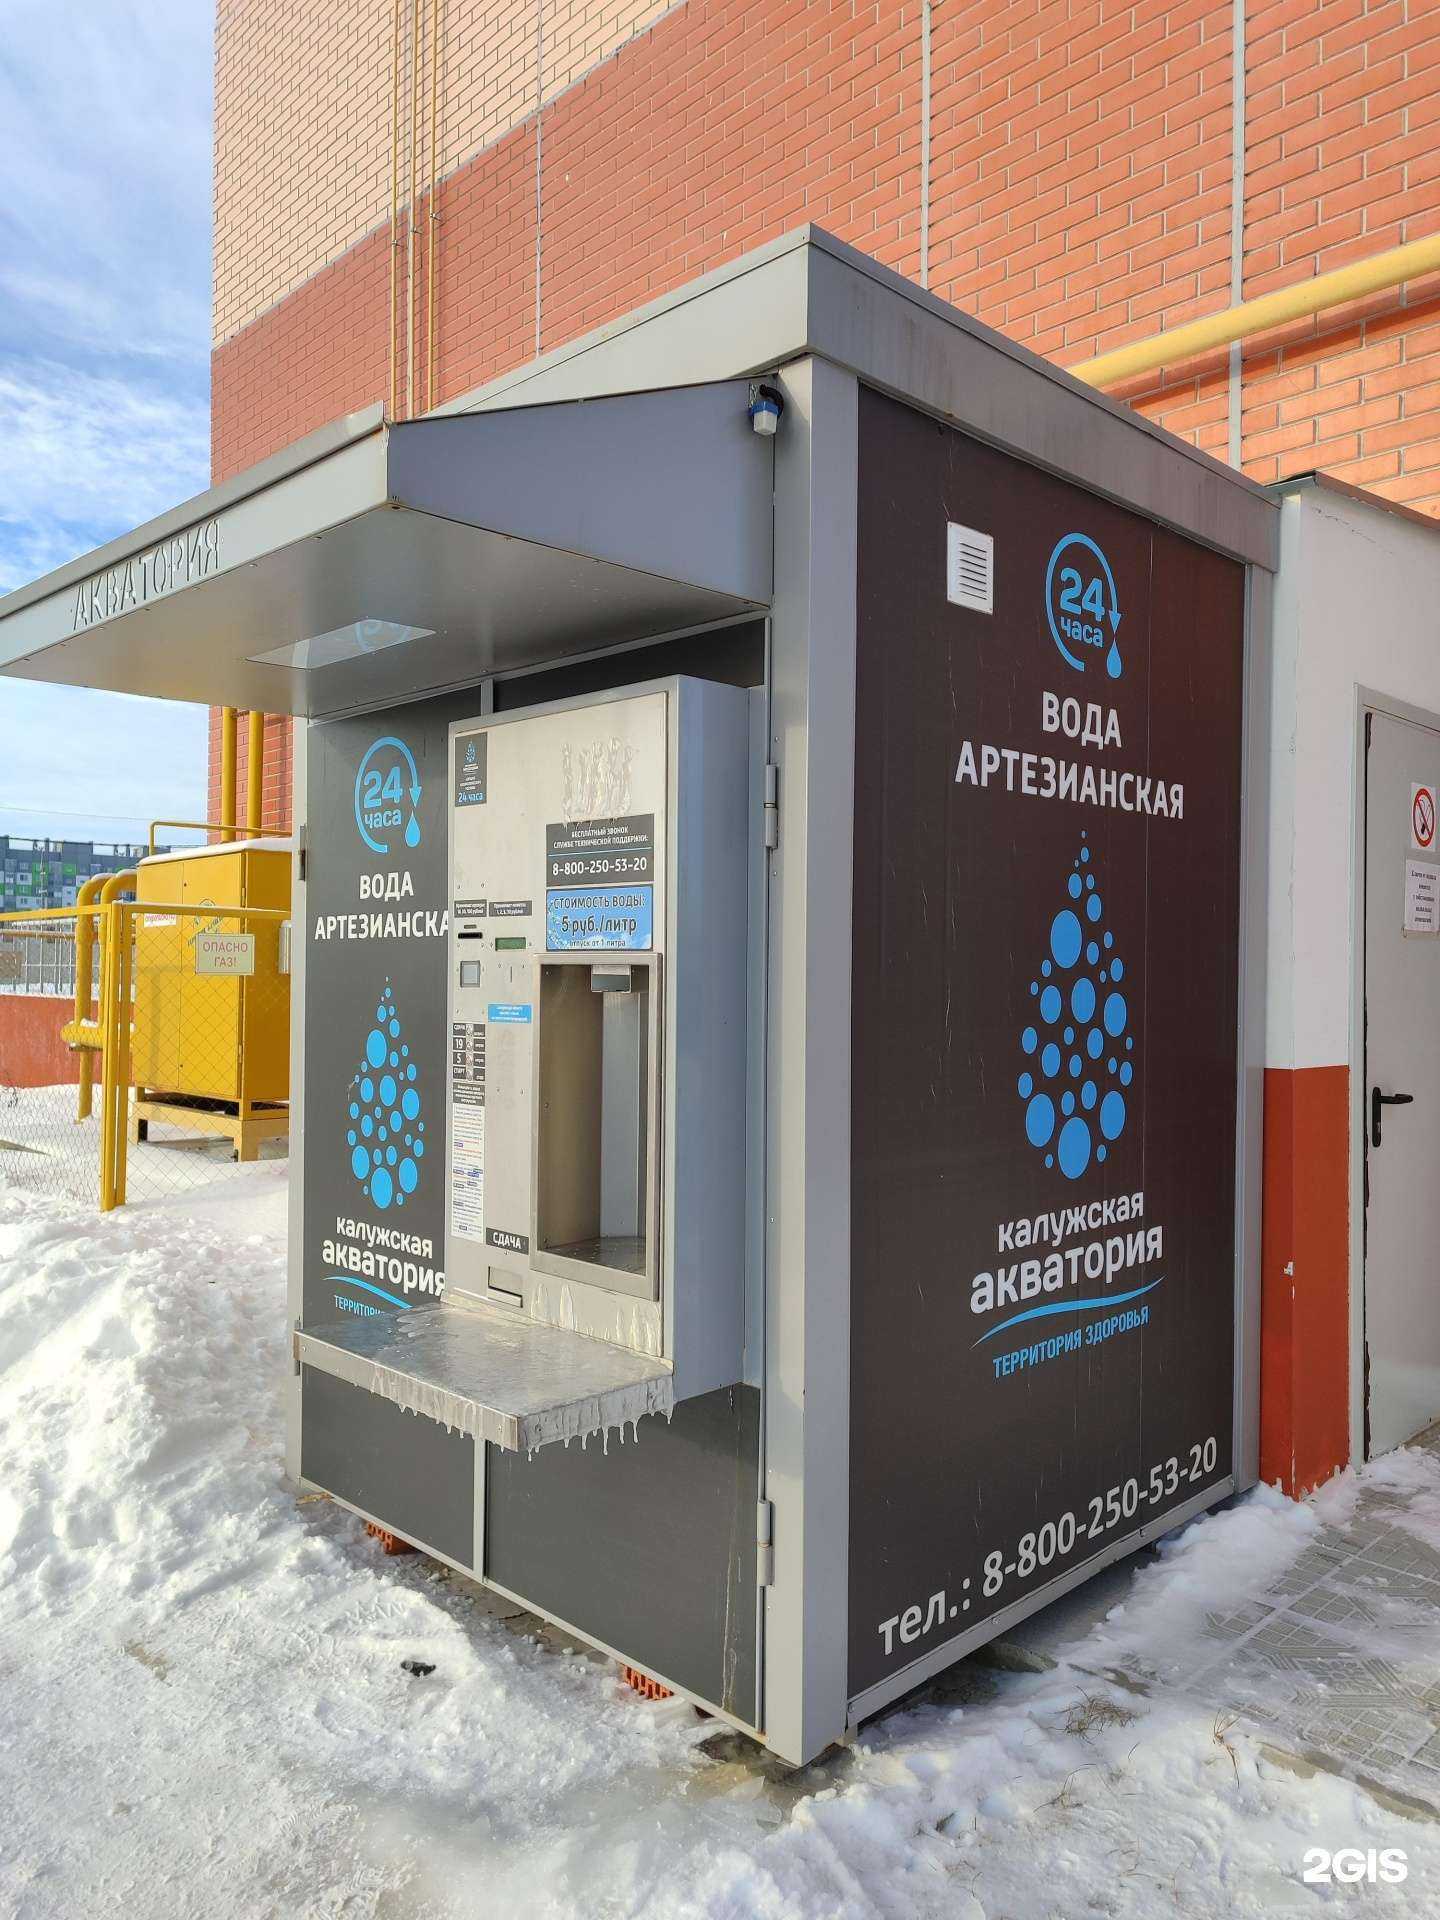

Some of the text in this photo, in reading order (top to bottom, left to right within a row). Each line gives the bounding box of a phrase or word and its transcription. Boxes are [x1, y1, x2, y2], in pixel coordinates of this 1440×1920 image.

[73, 519, 220, 630] АКВАТОРИЯ
[1060, 567, 1104, 621] 24
[1060, 616, 1103, 647] часа
[1042, 691, 1122, 750] ВОДА
[363, 766, 403, 809] 24
[955, 740, 1184, 819] АРТЕЗИАНСКАЯ
[364, 808, 402, 829] часа
[552, 857, 647, 876] 8-800-250-53-20
[359, 871, 414, 902] ВОДА
[554, 895, 645, 908] СТОИМОСТЬ ВОДЫ:
[561, 915, 637, 935] 5 руб./литр
[203, 942, 248, 953] ОПАСНО
[214, 957, 237, 967] ГАЗ!
[455, 1038, 464, 1049] 19
[456, 1053, 462, 1064] 5
[336, 1217, 433, 1259] калужская
[493, 1231, 522, 1249] СДАЧА
[998, 1192, 1145, 1252] калужская
[322, 1240, 446, 1297] акватория
[970, 1226, 1163, 1314] акватория
[992, 1305, 1150, 1378] ТЕРРИТОРИЯ ЗДОРОВЬЯ
[878, 1436, 1217, 1656] тел.: 8-800-250-53-20
